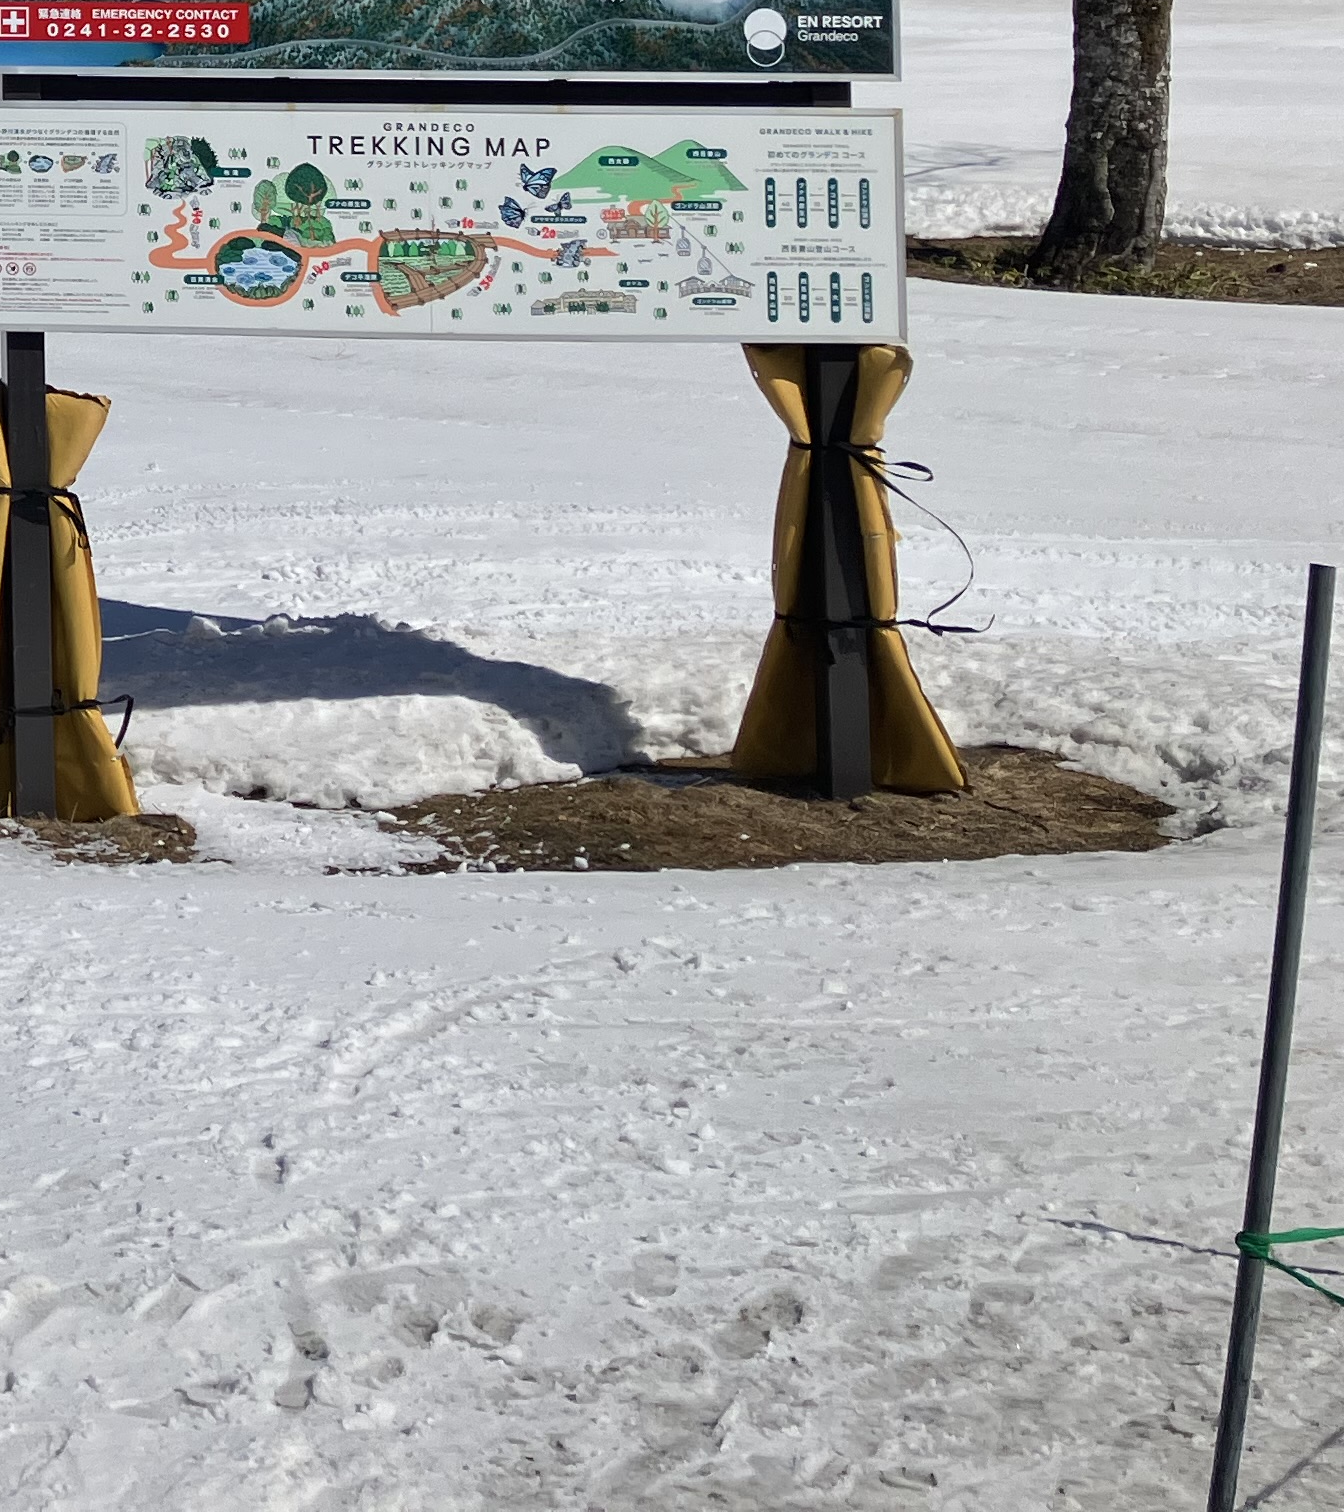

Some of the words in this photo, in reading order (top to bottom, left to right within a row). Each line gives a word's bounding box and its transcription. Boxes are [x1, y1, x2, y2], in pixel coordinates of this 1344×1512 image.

[92, 9, 173, 20] EMERGENCY
[176, 9, 238, 20] CONTACT
[798, 16, 818, 28] EN
[822, 16, 883, 28] RESORT
[47, 23, 230, 38] 0241-32-2530
[798, 31, 859, 42] Grandeco
[383, 122, 475, 132] GRANDECO
[307, 136, 471, 156] TREKKING
[486, 138, 551, 157] MAP
